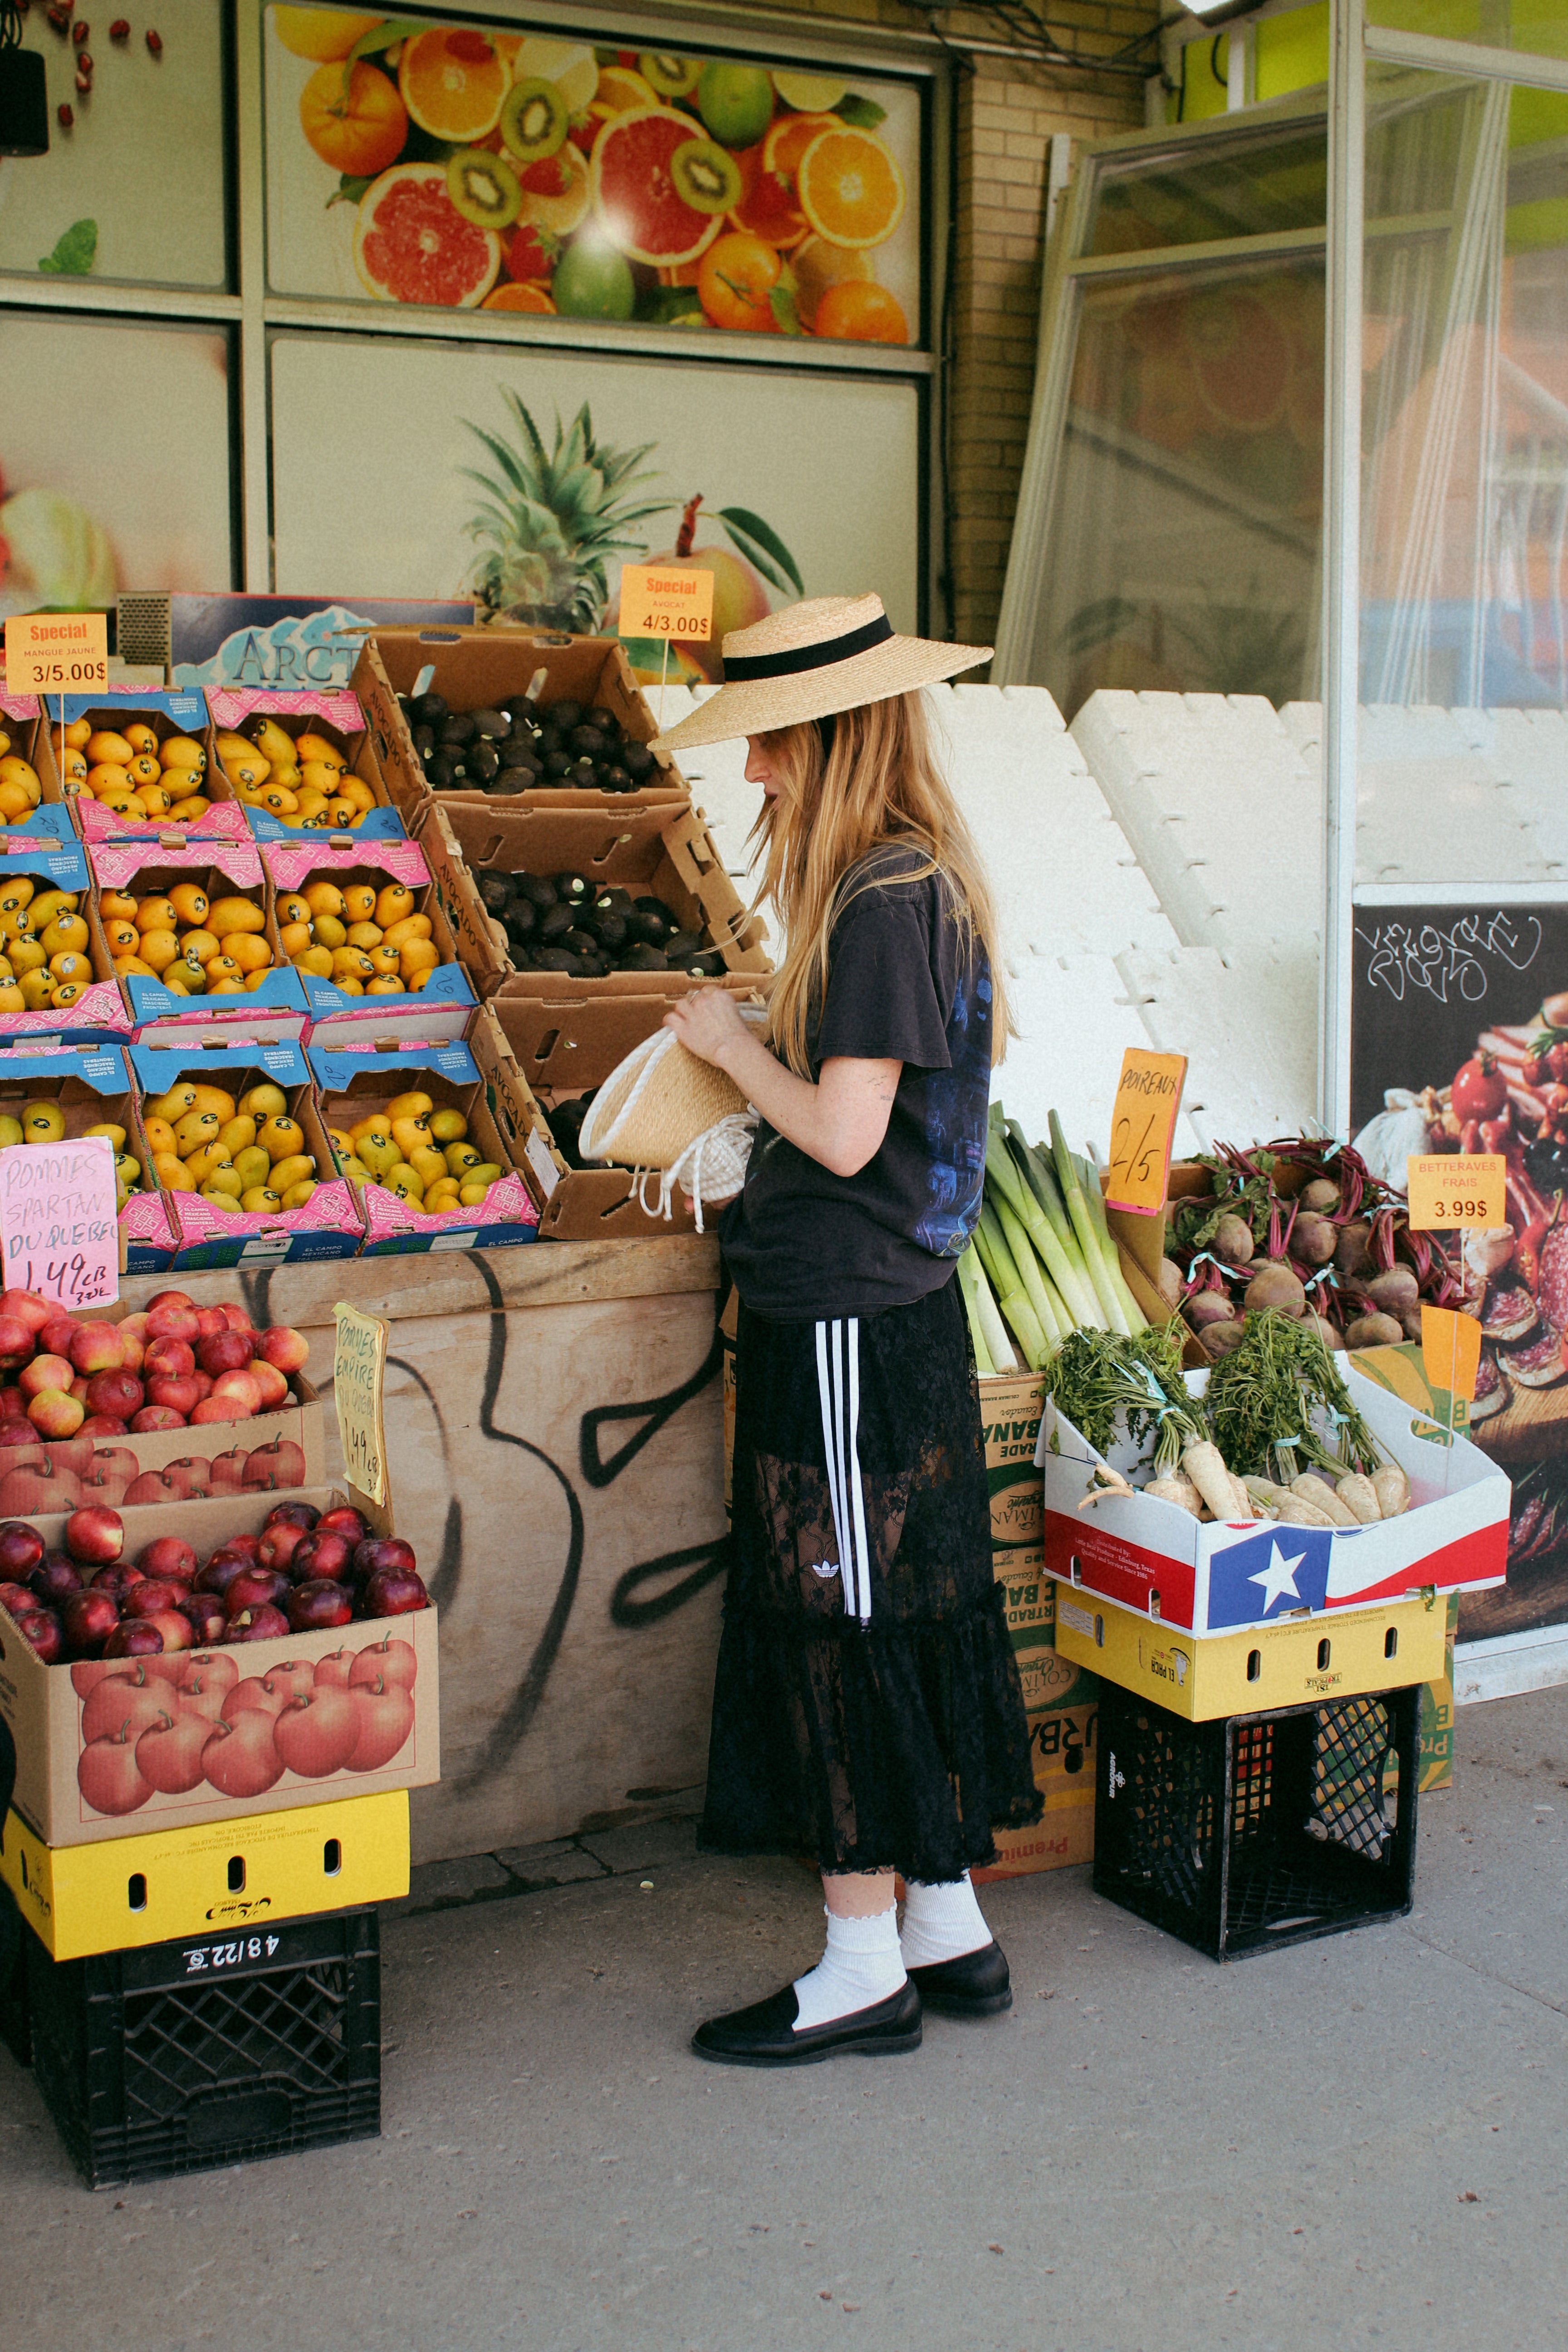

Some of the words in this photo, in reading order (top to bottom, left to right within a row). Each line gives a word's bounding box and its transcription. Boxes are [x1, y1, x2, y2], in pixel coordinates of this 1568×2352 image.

[647, 577, 697, 594] Special
[30, 623, 87, 642] Special
[643, 614, 708, 635] 4/3.00$
[24, 649, 63, 657] MANGUE
[33, 662, 105, 682] 3/5.00$
[370, 689, 400, 766] AVOCADO
[440, 863, 476, 946] AVOCADO
[1120, 1069, 1178, 1095] POIREAUX
[1112, 1114, 1161, 1184] 2/5
[6, 1154, 97, 1197] POMMES
[1419, 1162, 1496, 1172] BETTERAVES
[1443, 1178, 1477, 1187] FRAIS
[6, 1192, 105, 1226] SPARTAN
[1435, 1200, 1487, 1218] 3.99$
[10, 1226, 42, 1259] DU
[338, 1317, 375, 1358] POMMES
[336, 1355, 373, 1390] EMPIRE
[1000, 1406, 1038, 1418] Ecuador
[1081, 1548, 1097, 1560] Quality
[1107, 1559, 1123, 1570] Service
[1124, 1566, 1137, 1576] Since
[1137, 1571, 1148, 1580] 1986
[1087, 1542, 1097, 1551] Bear
[1097, 1546, 1114, 1558] Produce
[1118, 1555, 1140, 1570] Edinburg,
[1141, 1564, 1155, 1574] Texas
[1319, 1614, 1344, 1623] TROPICALS
[1327, 1621, 1349, 1629] STORAGE
[1350, 1615, 1386, 1626] RECOMMENDED
[1292, 1625, 1326, 1634] TEMPERATURE
[1021, 1669, 1071, 1688] COLIM
[1151, 1659, 1166, 1679] PACA
[1168, 1667, 1174, 1682] EL
[201, 1835, 234, 1845] TROPICALS
[235, 1836, 266, 1846] STOCKAGE
[277, 1827, 319, 1839] TEMPÉRATURE
[186, 1842, 234, 1855] RECOMMANDÉE
